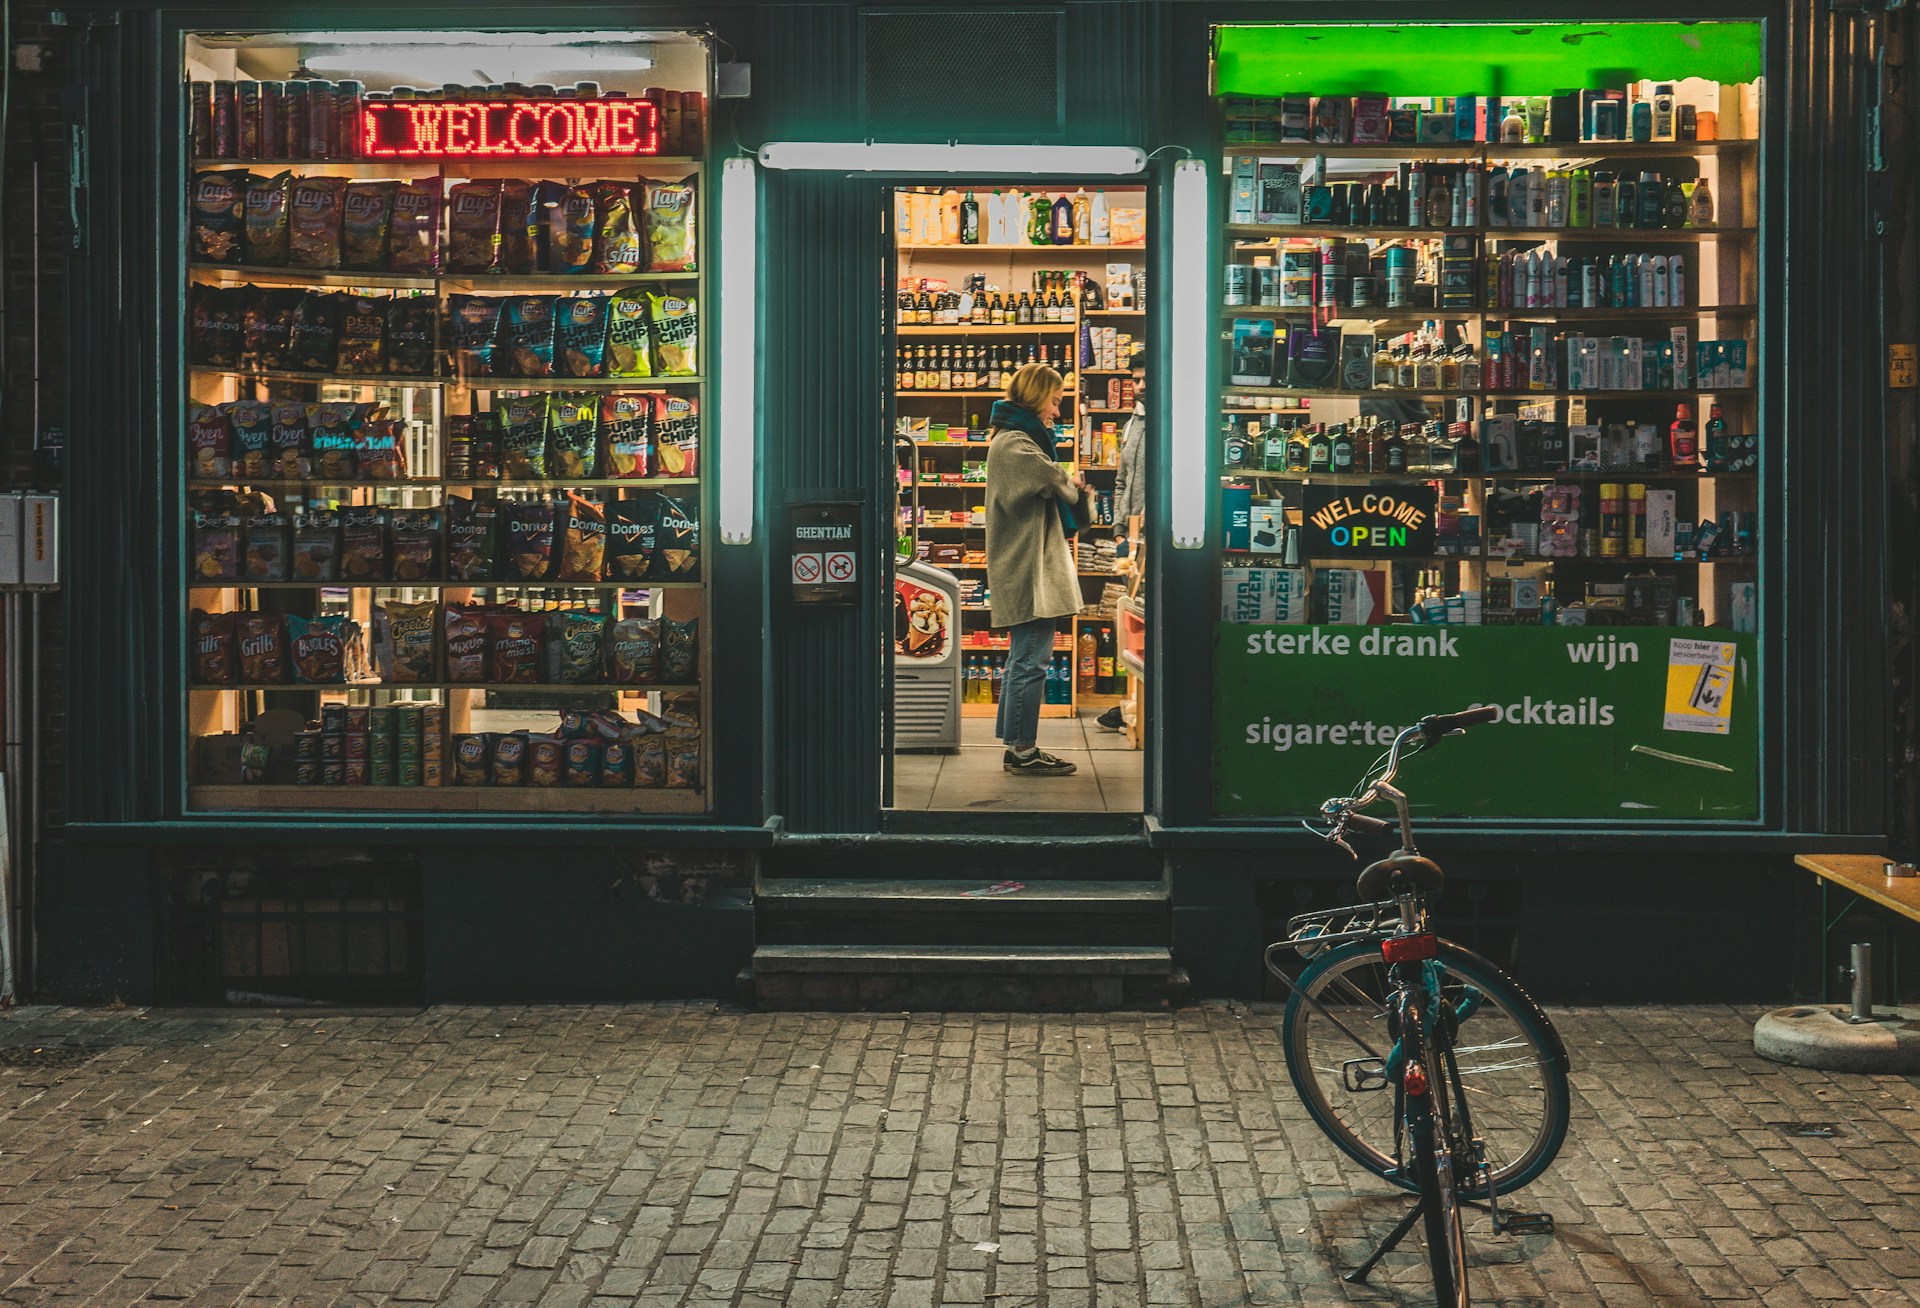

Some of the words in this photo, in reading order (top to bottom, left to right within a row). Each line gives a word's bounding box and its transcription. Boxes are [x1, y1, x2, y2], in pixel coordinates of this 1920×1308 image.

[408, 104, 640, 152] WELCOME
[1303, 187, 1311, 223] DENIM
[346, 315, 382, 327] DEEP
[1676, 335, 1685, 364] Signal
[1532, 353, 1542, 383] Signa
[1103, 497, 1112, 522] OREO
[1310, 493, 1427, 531] WELCOME
[451, 524, 488, 535] Doritos
[511, 519, 554, 533] Doritos
[611, 522, 655, 535] Doritos
[796, 526, 852, 539] GHENTIAN
[1331, 526, 1407, 547] OPEN
[1249, 570, 1262, 620] GIZEH
[1276, 571, 1289, 621] GIZEH
[1329, 572, 1342, 622] GIZEH
[391, 616, 432, 640] Cheetos
[563, 620, 603, 641] Cheetos
[241, 633, 274, 657] Grills
[298, 636, 338, 658] BUGLES
[495, 638, 530, 651] Mama
[614, 640, 650, 652] Mama
[1246, 626, 1351, 655] sterke
[1358, 627, 1460, 658] drank
[1566, 635, 1639, 671] wijn
[1673, 641, 1693, 650] Koop
[1694, 642, 1711, 650] hier
[1712, 644, 1719, 653] je
[1245, 716, 1416, 752] sigarette
[1466, 694, 1615, 726] ocktails
